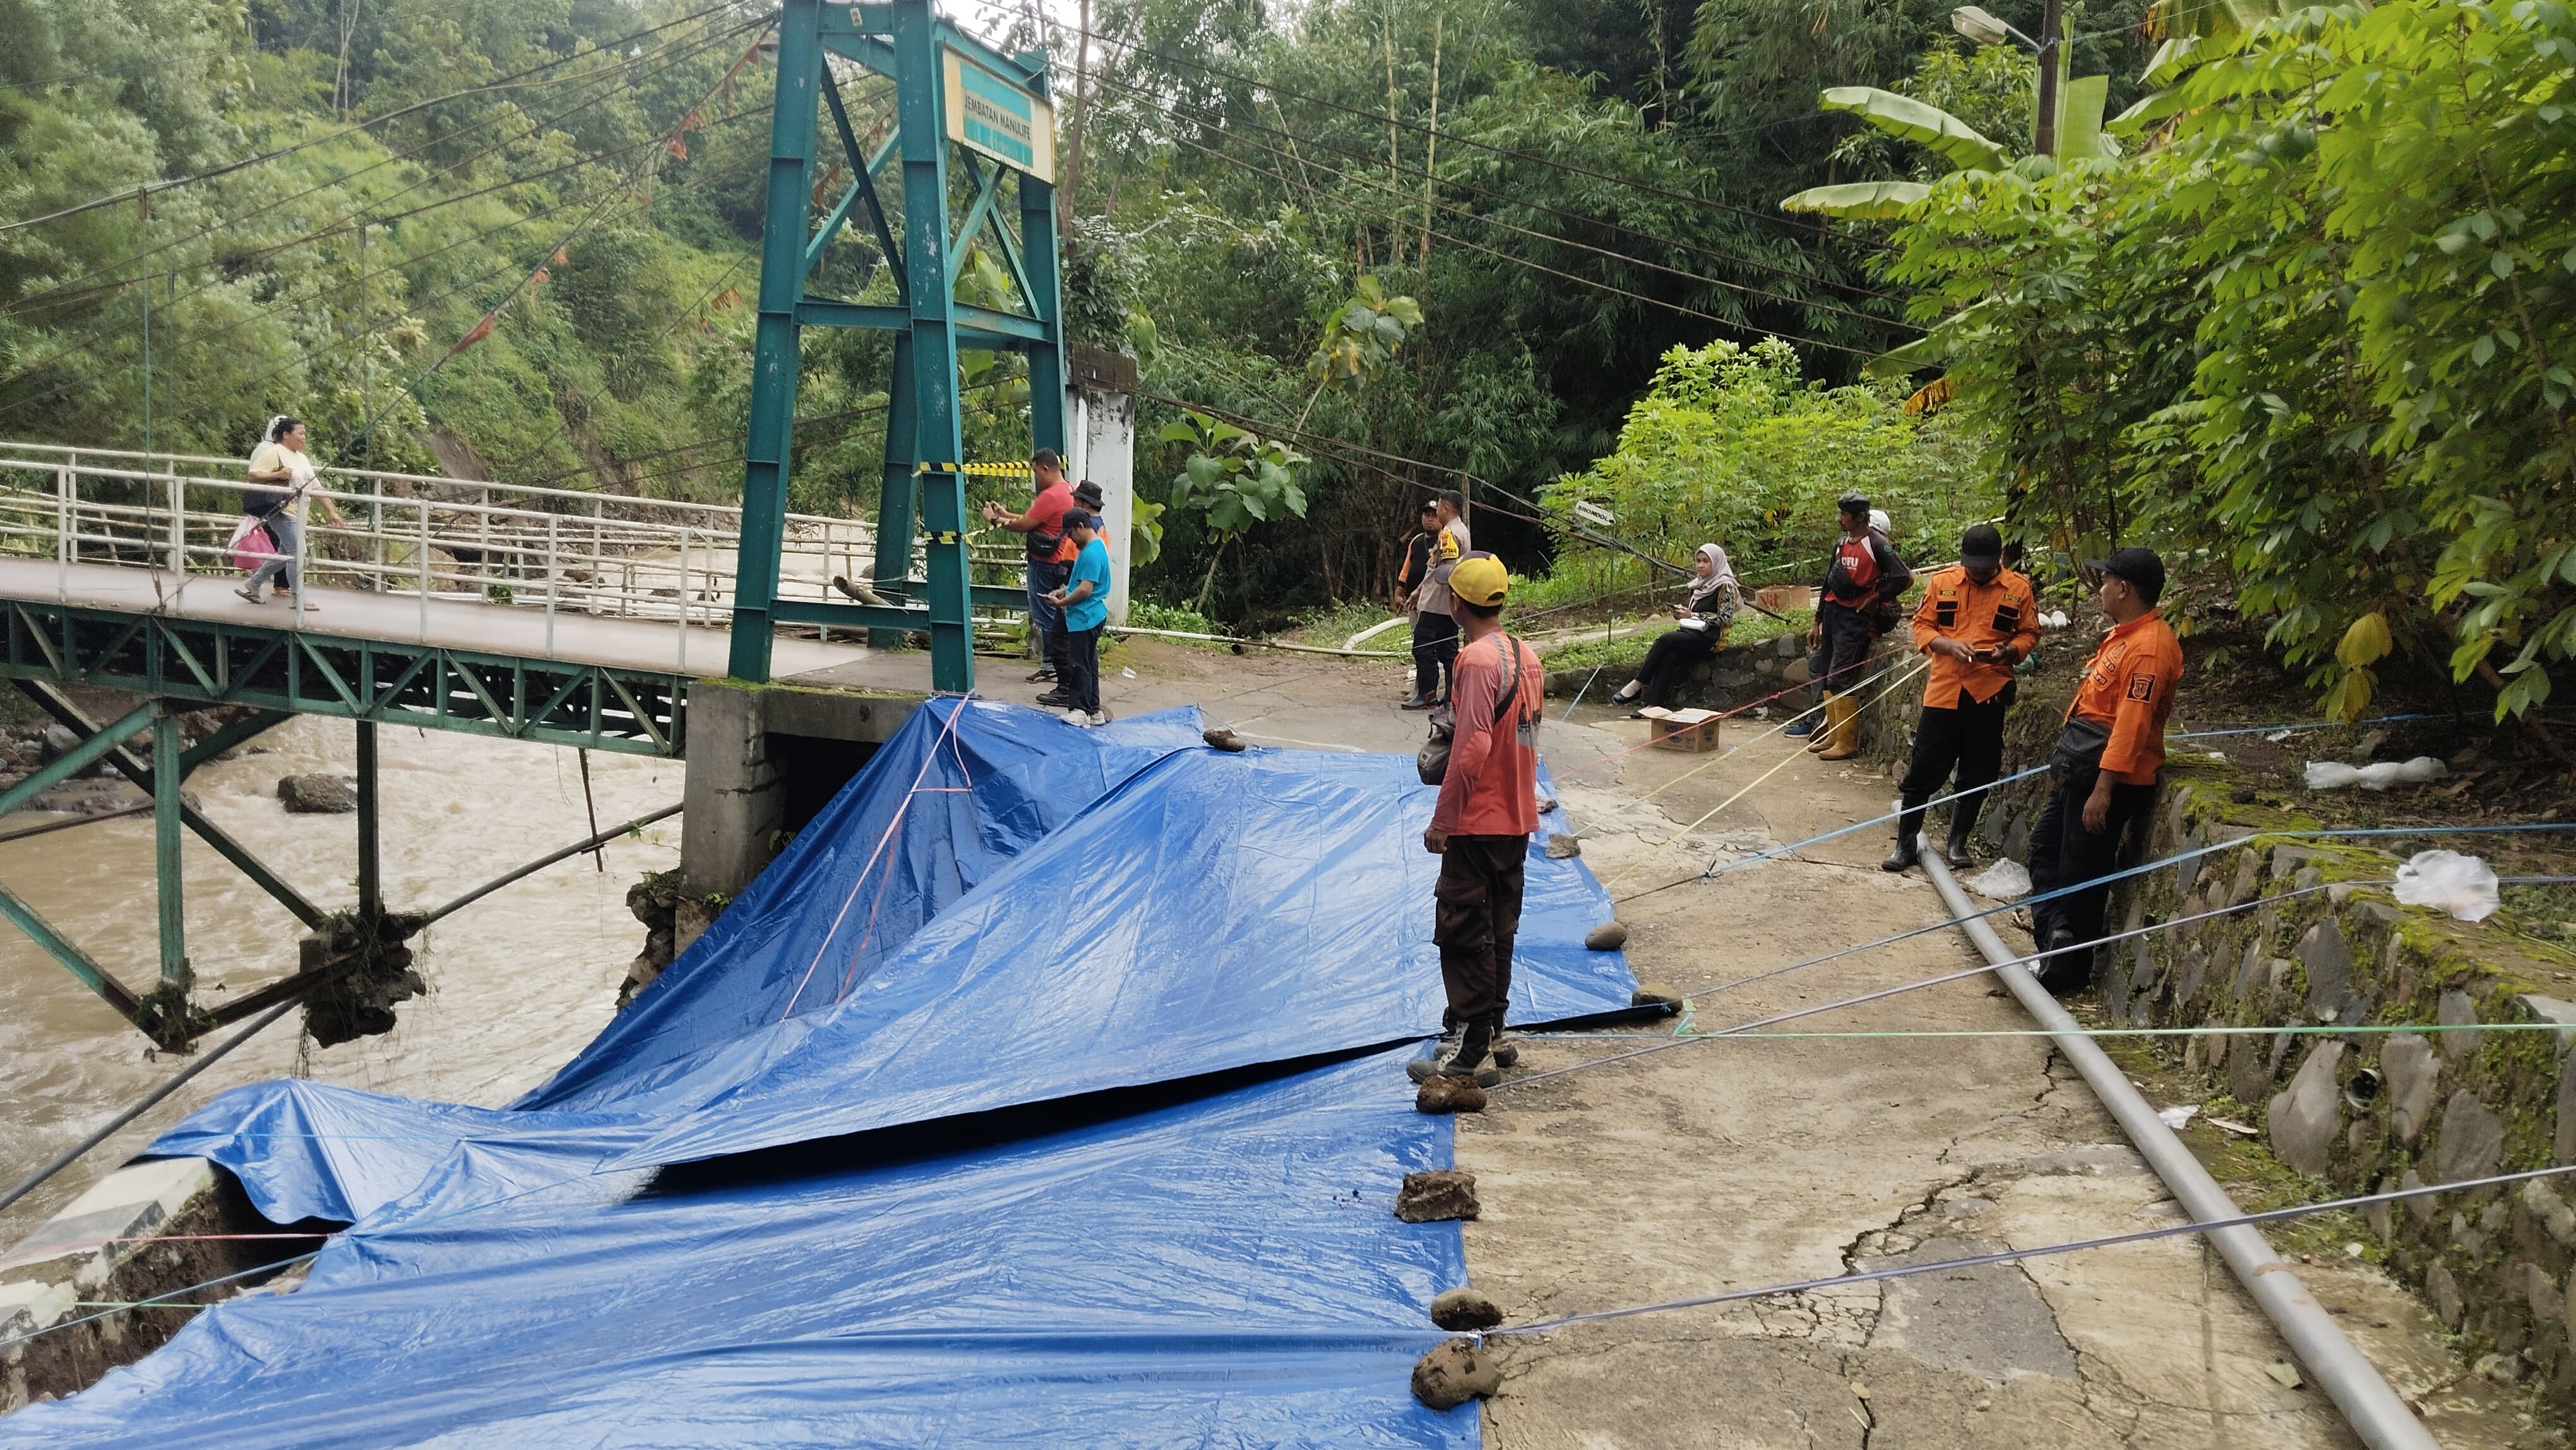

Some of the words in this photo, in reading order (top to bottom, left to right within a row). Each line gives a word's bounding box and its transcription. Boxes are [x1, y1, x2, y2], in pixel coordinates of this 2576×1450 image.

[964, 94, 999, 124] JEMBATAN
[1000, 112, 1031, 140] MANULIFE
[1577, 505, 1608, 521] SRONDOL
